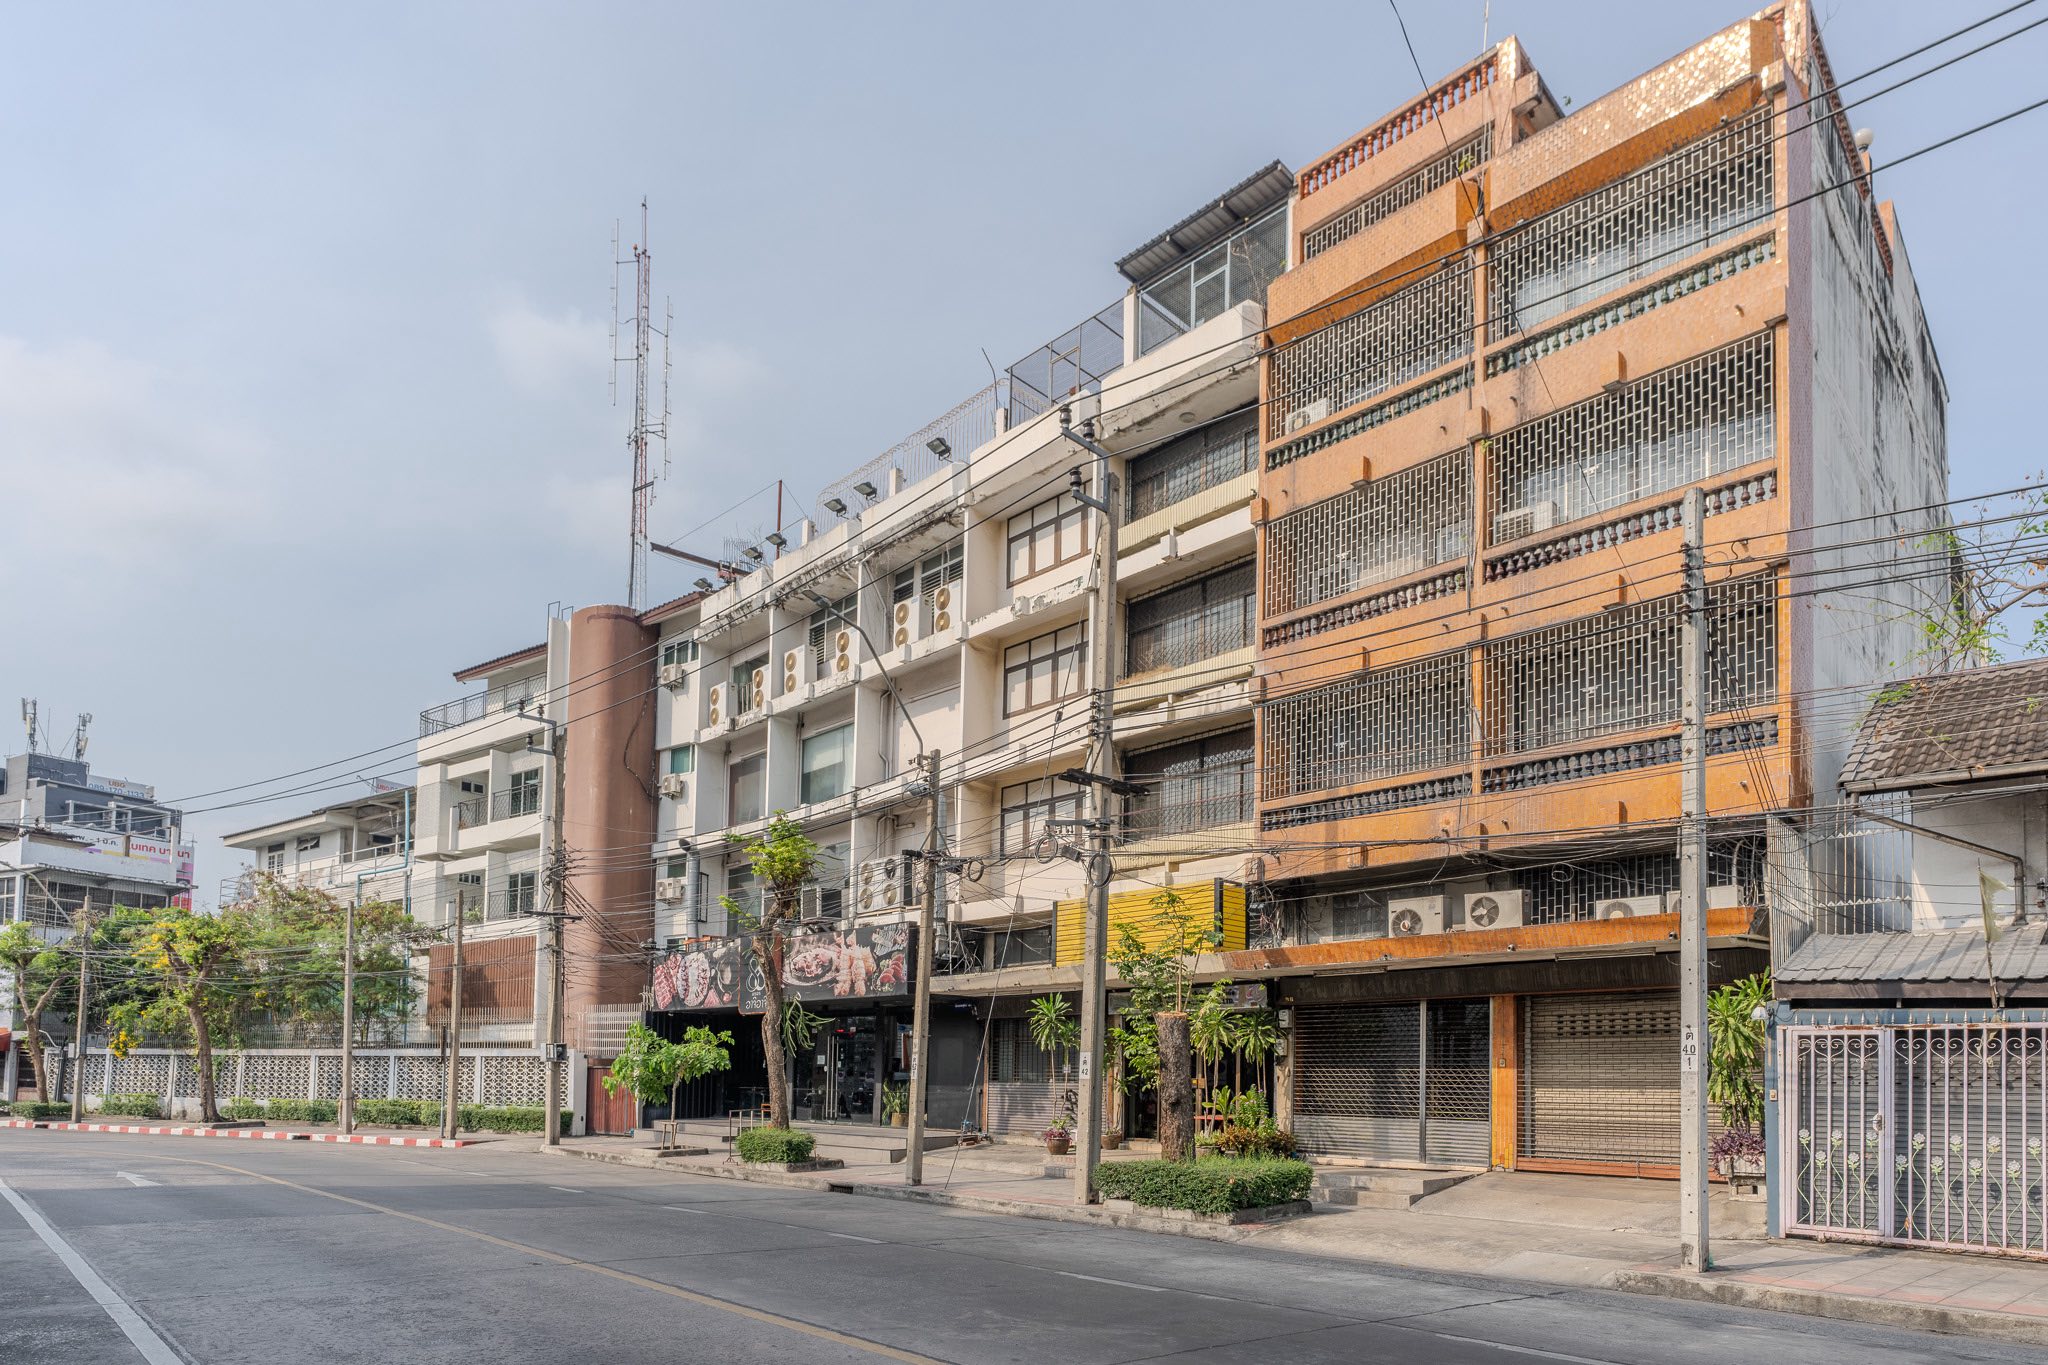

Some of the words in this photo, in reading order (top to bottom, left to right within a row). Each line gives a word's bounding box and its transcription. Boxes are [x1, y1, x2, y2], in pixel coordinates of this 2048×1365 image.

[129, 843, 156, 854] บเทค
[1682, 1044, 1696, 1054] 40
[1081, 1068, 1089, 1076] 42
